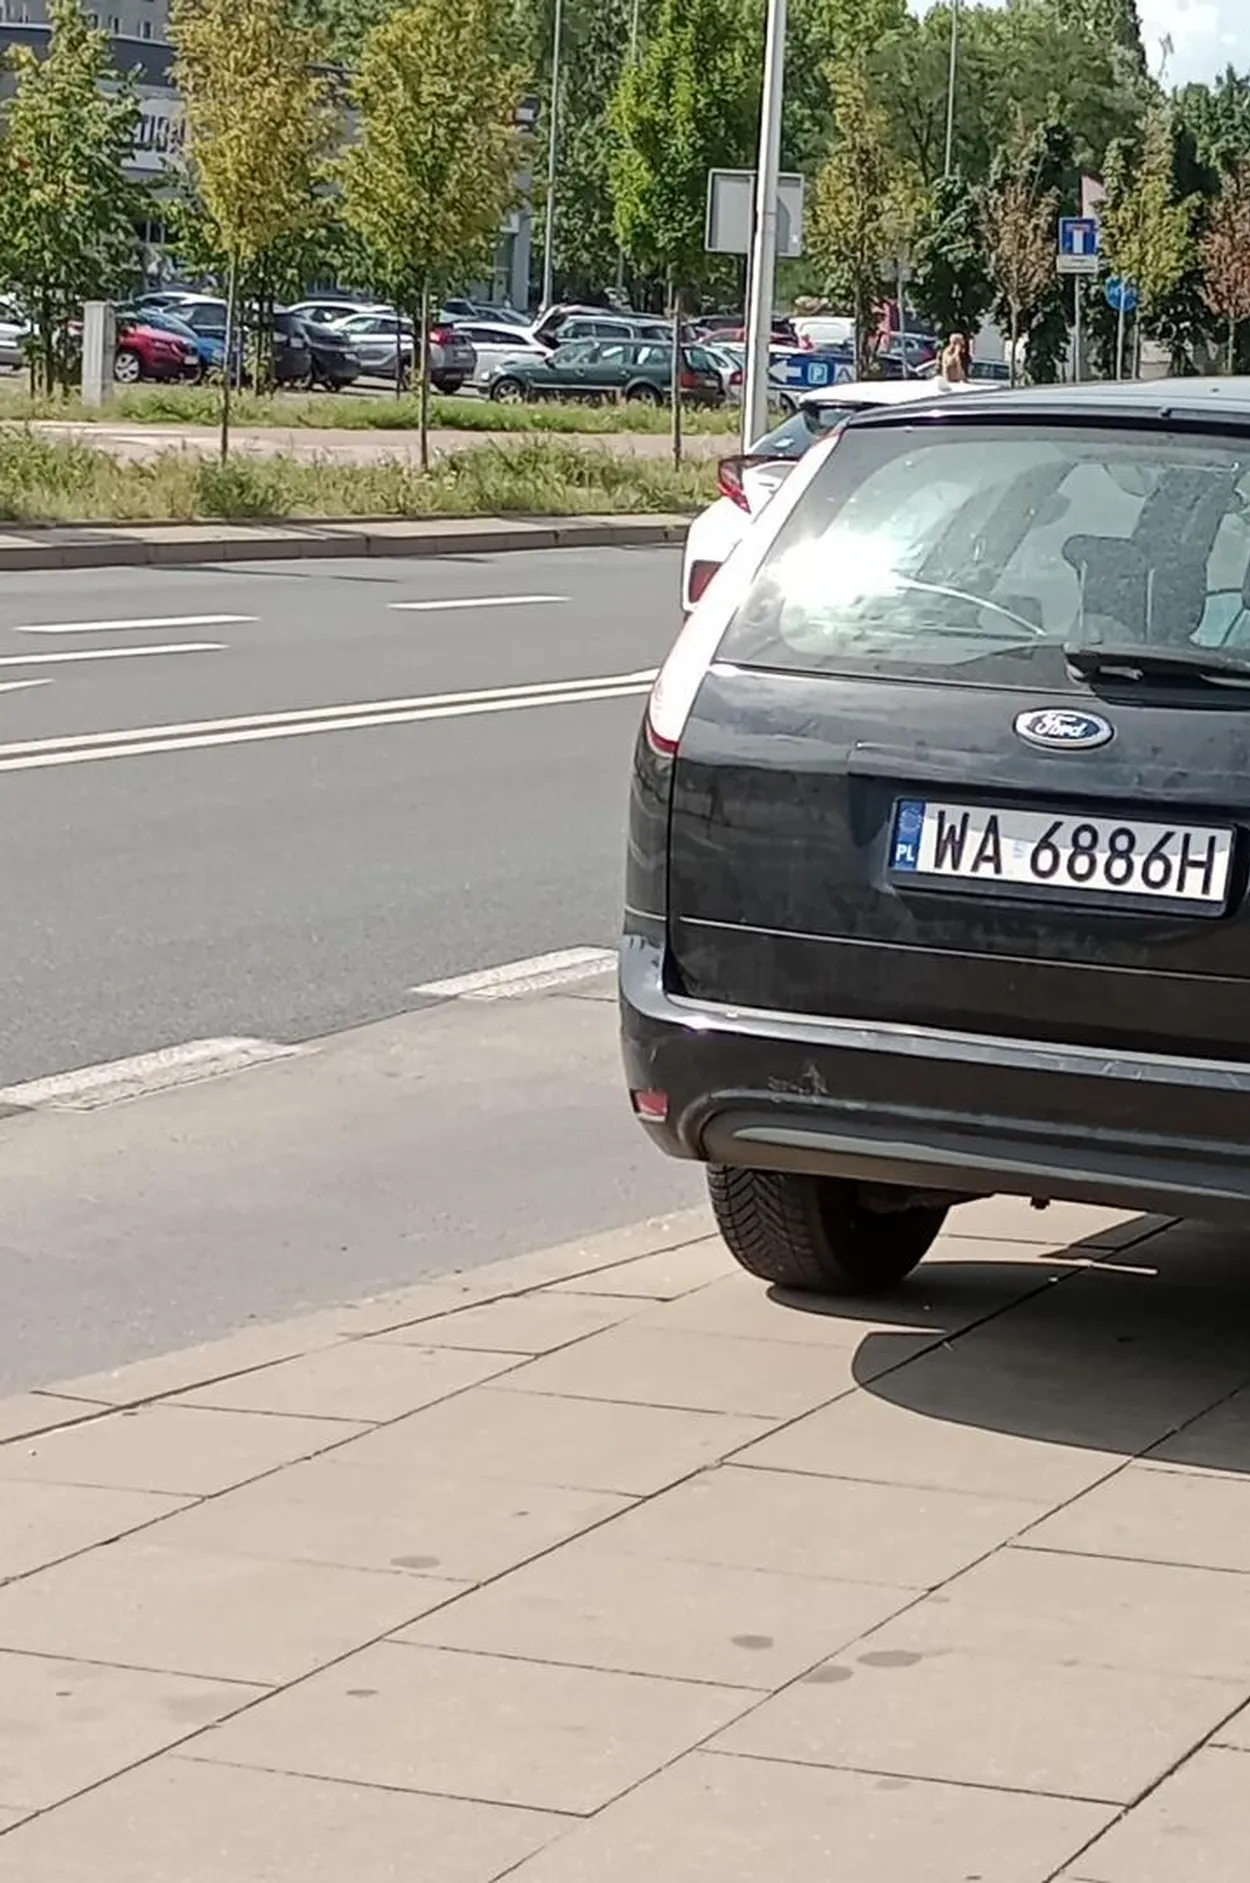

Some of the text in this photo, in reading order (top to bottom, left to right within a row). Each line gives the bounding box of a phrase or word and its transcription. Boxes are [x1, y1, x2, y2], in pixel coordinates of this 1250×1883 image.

[895, 843, 916, 862] PL
[932, 810, 1217, 896] WA 6886H
